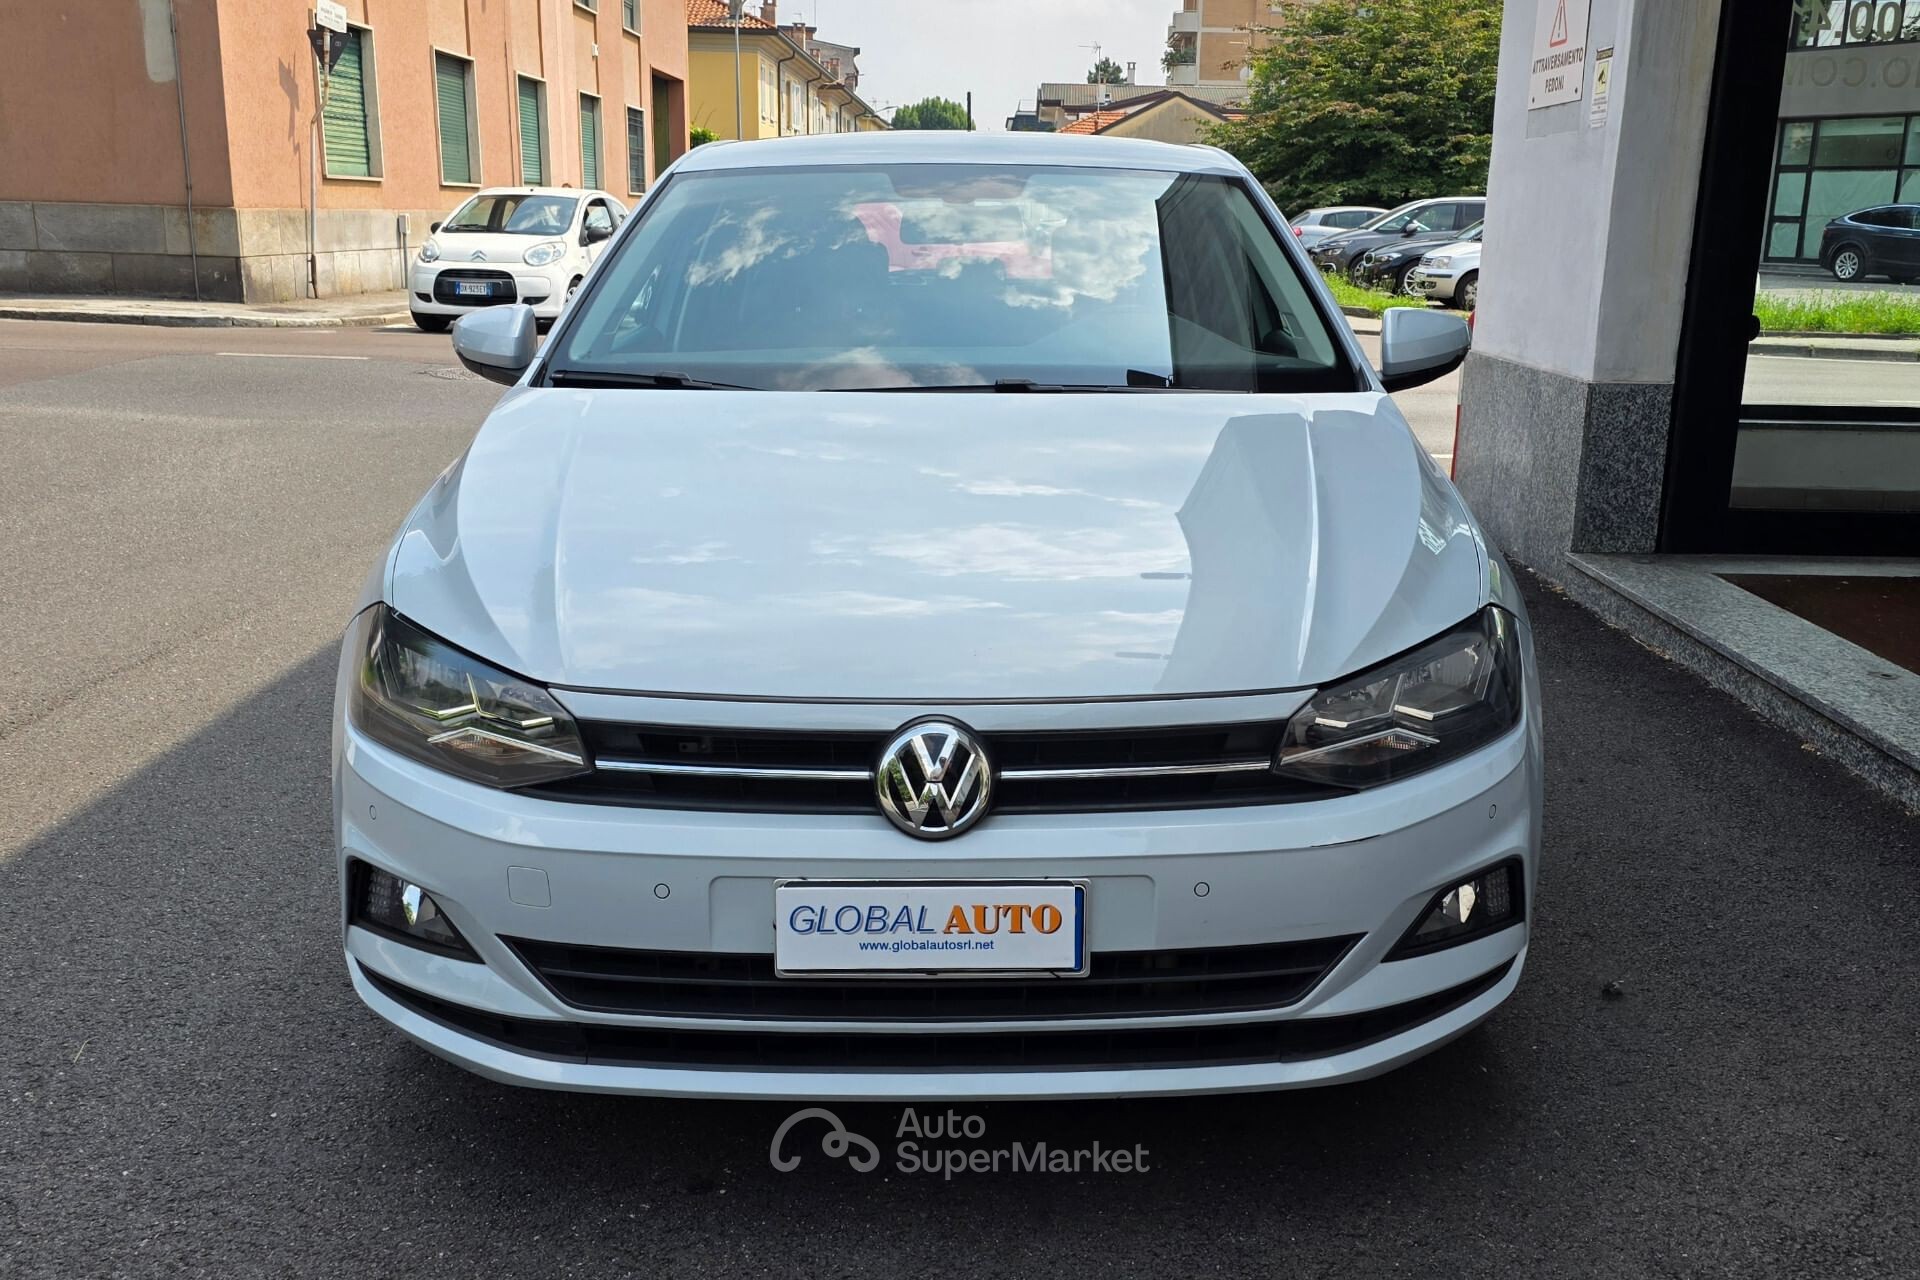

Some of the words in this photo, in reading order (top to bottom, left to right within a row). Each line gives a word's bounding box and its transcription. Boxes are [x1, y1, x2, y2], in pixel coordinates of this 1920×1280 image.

[1532, 47, 1584, 75] ATTRAVERSAMENTO
[1544, 75, 1565, 93] PEDONI
[788, 905, 936, 935] GLOBAL
[943, 904, 1063, 935] AUTO
[859, 939, 995, 953] www.globalautosrl.net
